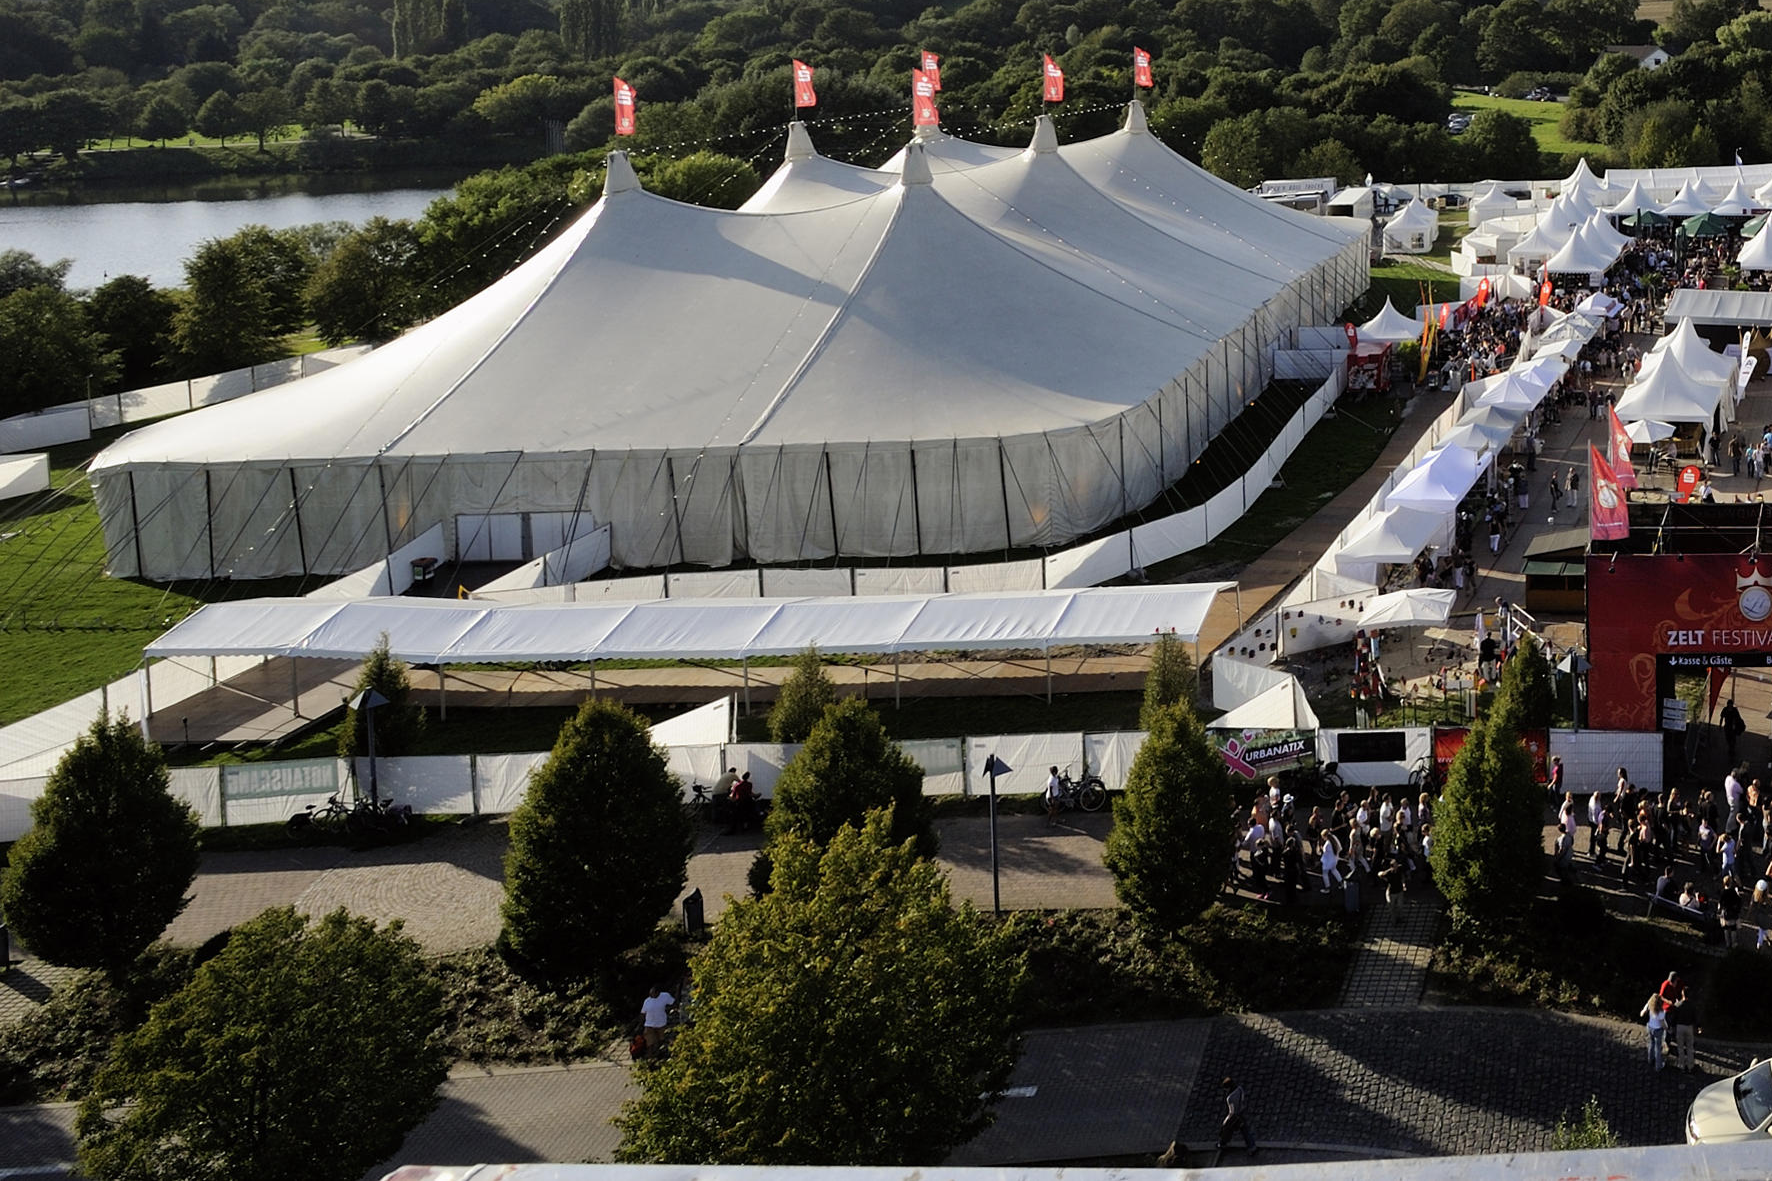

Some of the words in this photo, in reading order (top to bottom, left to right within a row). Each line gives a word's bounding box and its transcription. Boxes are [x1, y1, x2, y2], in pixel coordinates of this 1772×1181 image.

[1667, 630, 1705, 646] ZELT
[1678, 656, 1700, 665] Kasse
[1702, 657, 1709, 665] &
[1710, 655, 1733, 665] Gäste
[1245, 740, 1305, 762] URBANATIX
